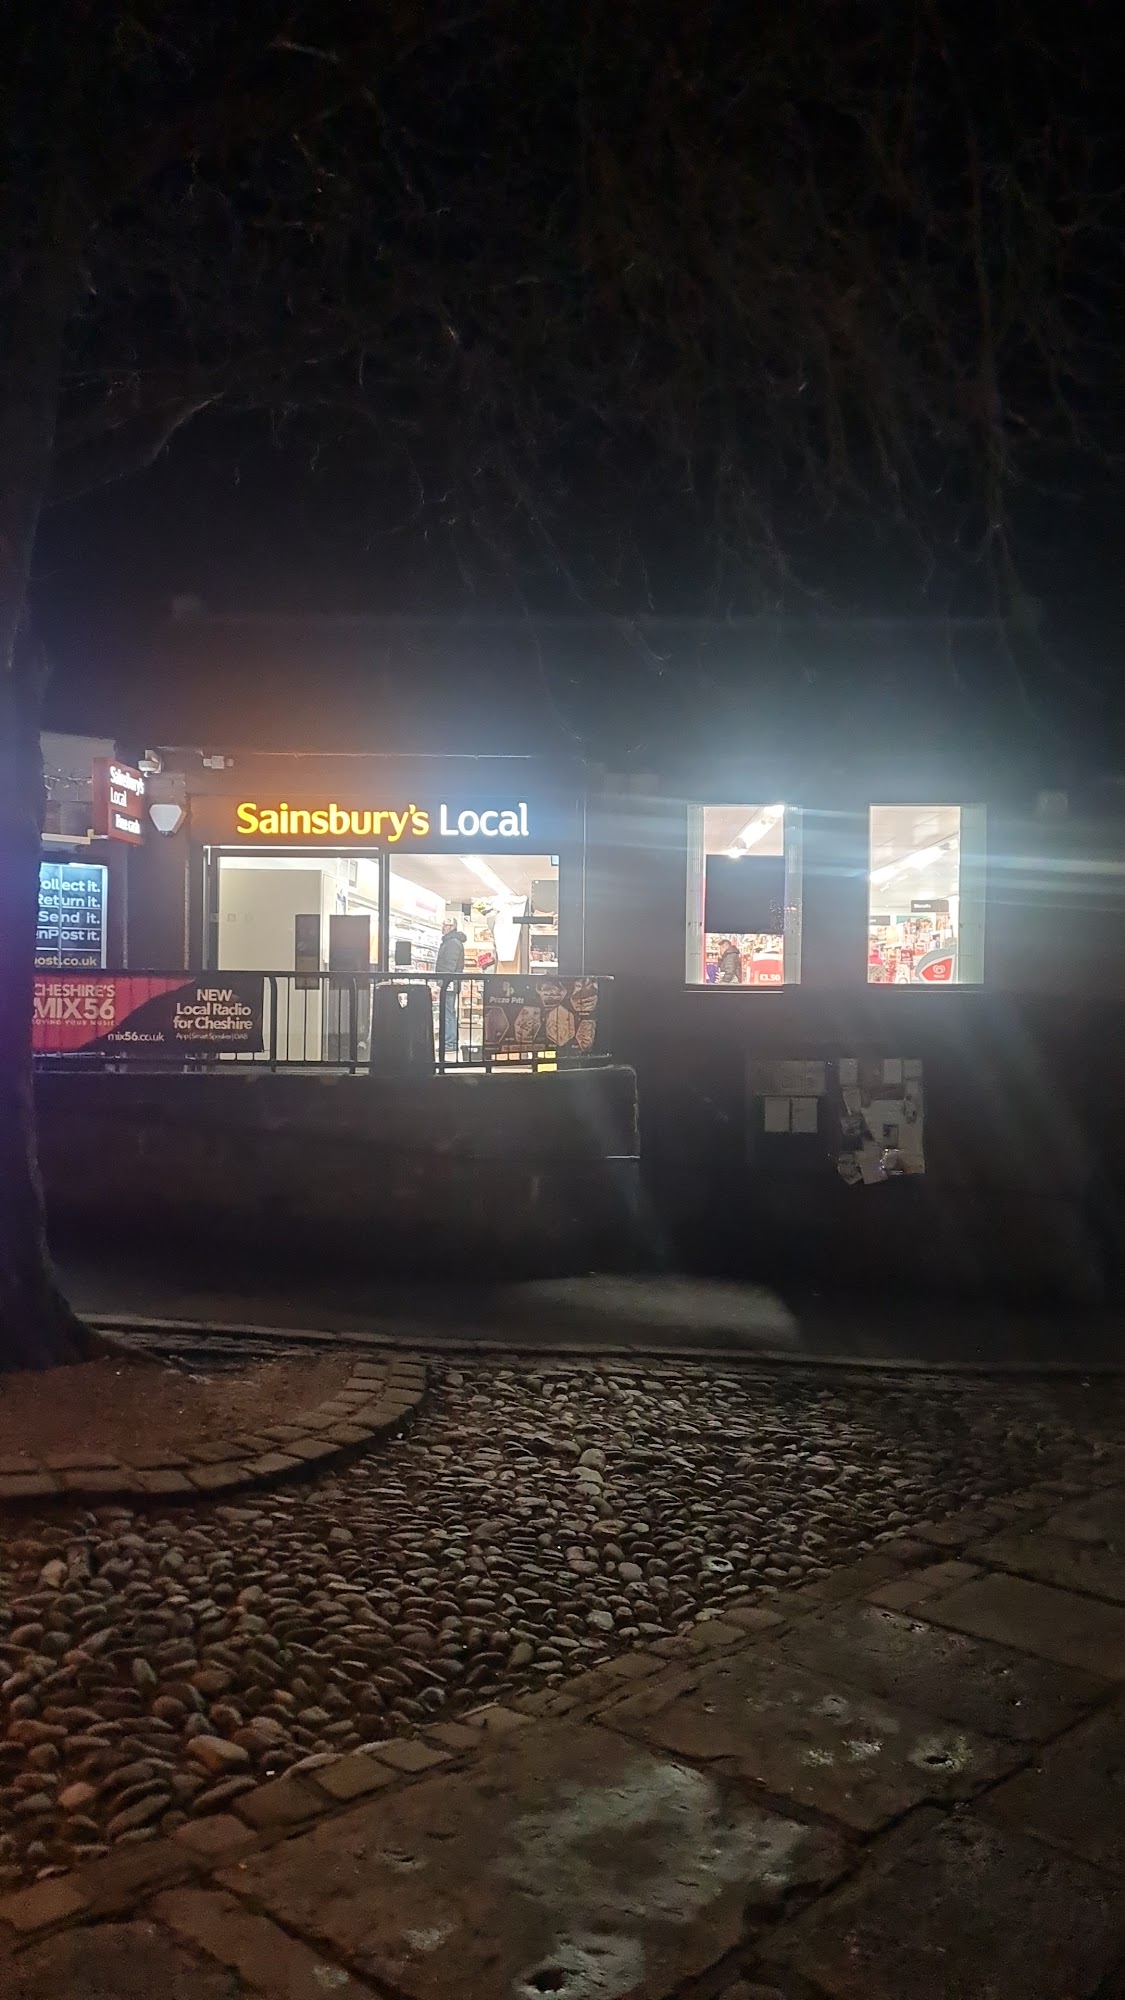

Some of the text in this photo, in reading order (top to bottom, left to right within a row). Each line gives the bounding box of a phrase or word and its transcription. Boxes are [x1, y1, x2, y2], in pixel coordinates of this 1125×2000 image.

[110, 787, 127, 807] Local
[236, 802, 529, 842] Sainsbury's Local
[41, 878, 101, 892] ollect it.
[87, 896, 101, 908] it.
[38, 910, 101, 924] Send it.
[87, 930, 101, 941] it.
[35, 955, 97, 967] ost.co.uk
[759, 973, 781, 982] £1.50
[34, 983, 115, 997] CHESHIRE'S
[196, 988, 233, 1002] NEW
[176, 1002, 252, 1016] Local Radio
[173, 1015, 254, 1030] for Cheshire
[107, 1031, 165, 1042] mix56.co.uk
